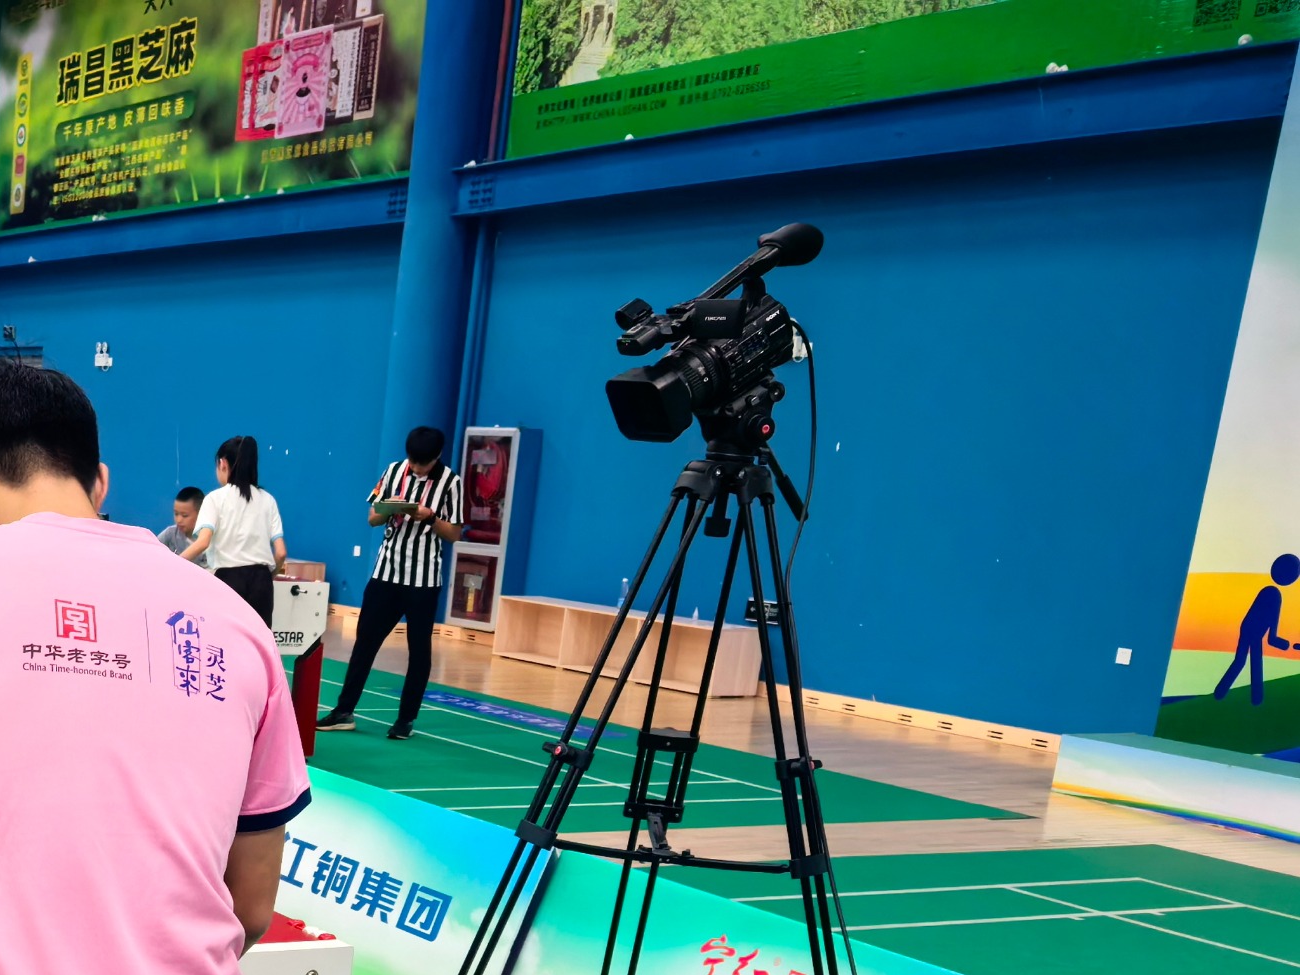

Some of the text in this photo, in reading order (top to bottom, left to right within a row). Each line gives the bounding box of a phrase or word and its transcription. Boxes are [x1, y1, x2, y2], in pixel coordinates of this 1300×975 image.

[56, 17, 198, 107] 瑞昌黑芝麻
[62, 113, 118, 142] 千年原产地
[22, 643, 131, 669] 中华老字号
[22, 662, 133, 681] China Time-honored Brand
[165, 611, 201, 697] 仙客来
[206, 644, 226, 702] 灵芝
